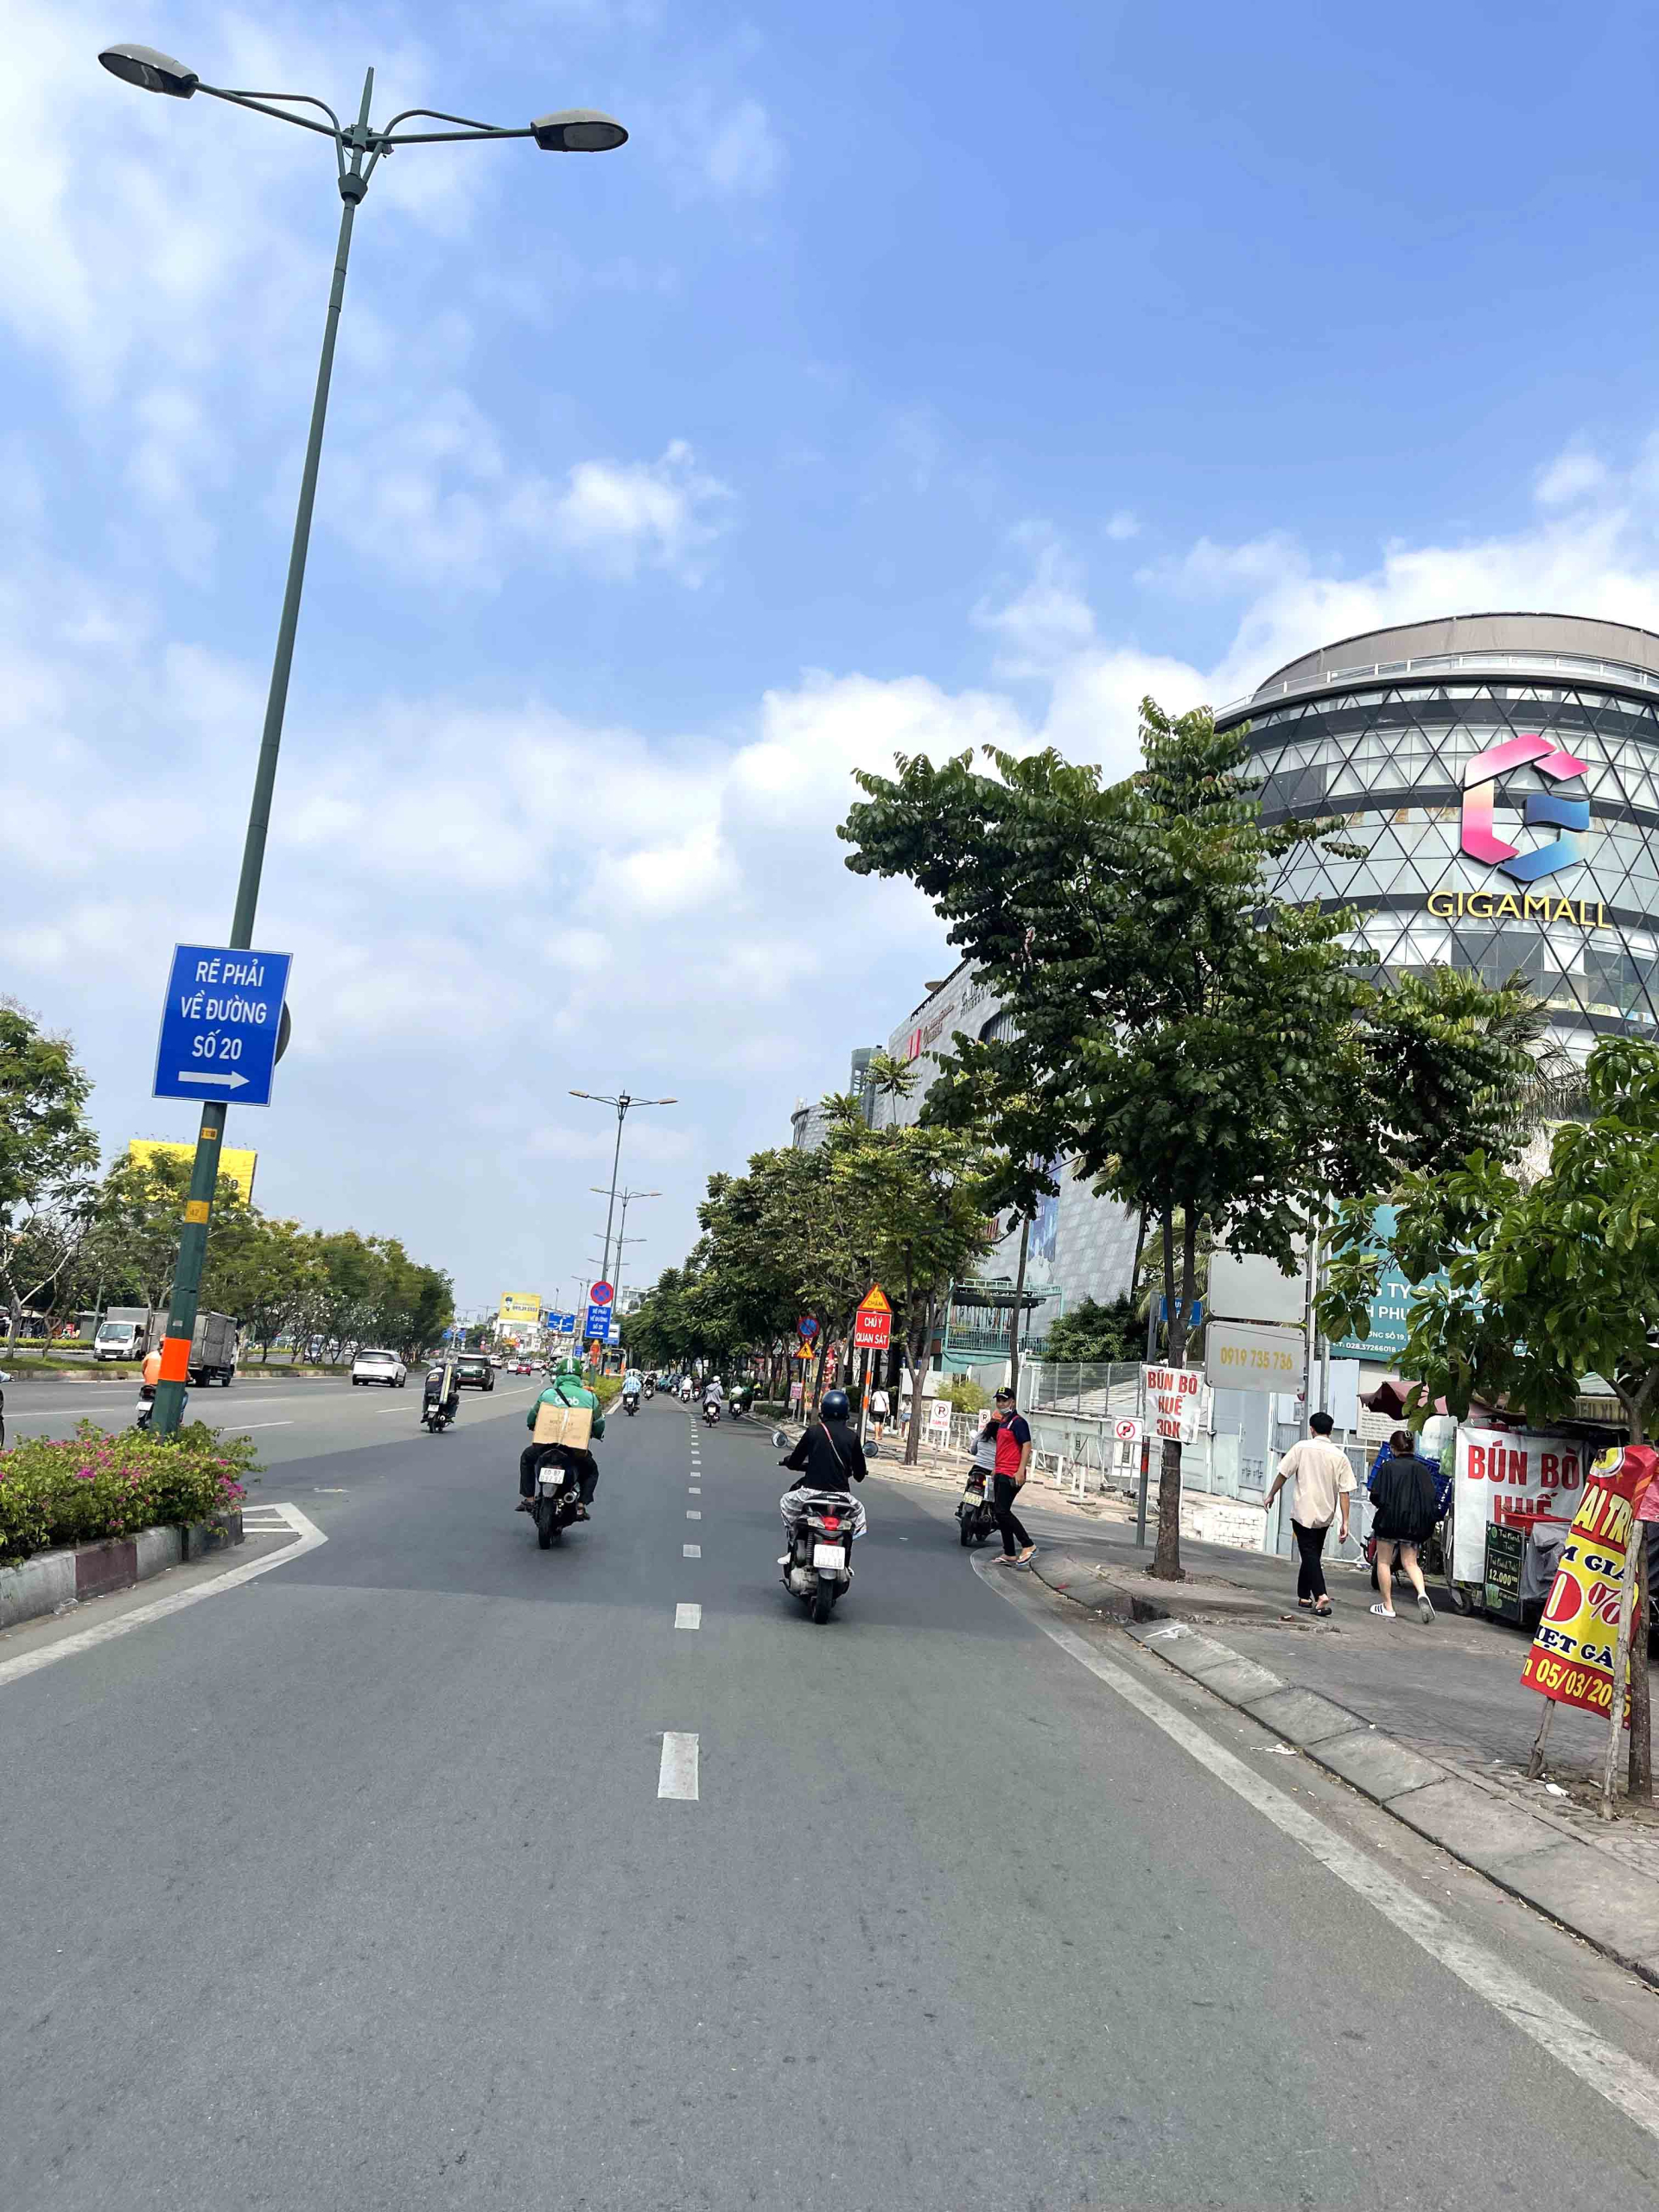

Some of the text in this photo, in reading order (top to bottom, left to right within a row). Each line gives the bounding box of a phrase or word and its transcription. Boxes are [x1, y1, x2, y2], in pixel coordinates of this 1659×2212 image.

[1427, 891, 1612, 929] GIGAMALL
[195, 957, 264, 987] RẼ PHẢI
[181, 989, 267, 1024] VỀ ĐƯỜNG
[192, 1029, 243, 1060] SỐ 20
[1387, 1283, 1411, 1300] TY
[864, 1315, 883, 1328] CHÚ Ý
[855, 1332, 887, 1344] QUAN SÁT
[1220, 1346, 1247, 1366] 0919
[1250, 1349, 1269, 1368] 735
[1147, 1369, 1198, 1395] BÚN BÒ
[555, 1396, 580, 1406] Gab
[1158, 1395, 1186, 1416] HUẾ
[1156, 1418, 1181, 1440] 30K
[1468, 1440, 1580, 1491] BÚN BÒ
[1489, 1568, 1511, 1586] 12.000
